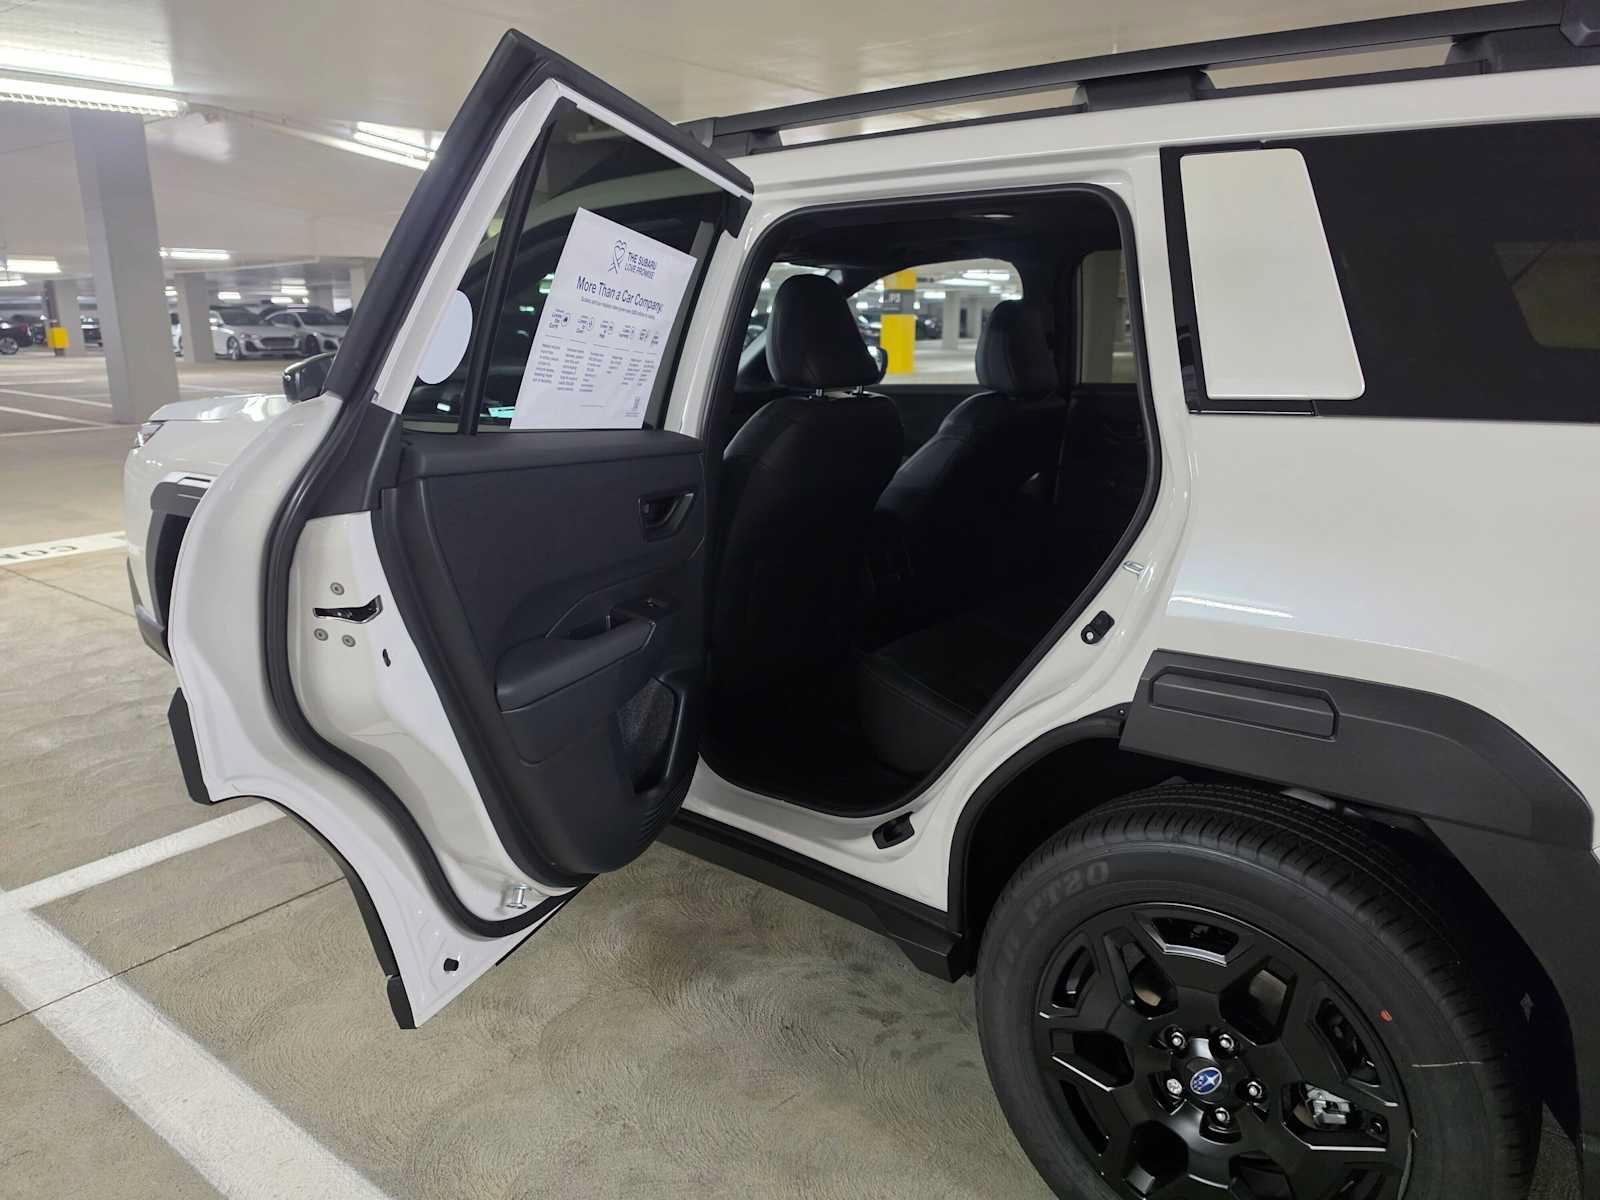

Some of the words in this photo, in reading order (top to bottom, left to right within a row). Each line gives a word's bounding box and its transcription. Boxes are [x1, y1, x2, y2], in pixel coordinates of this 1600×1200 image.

[627, 251, 639, 264] THE
[638, 255, 657, 271] SUBARU
[576, 276, 596, 293] More
[598, 281, 616, 299] Than
[615, 290, 622, 301] a
[621, 289, 635, 304] Car
